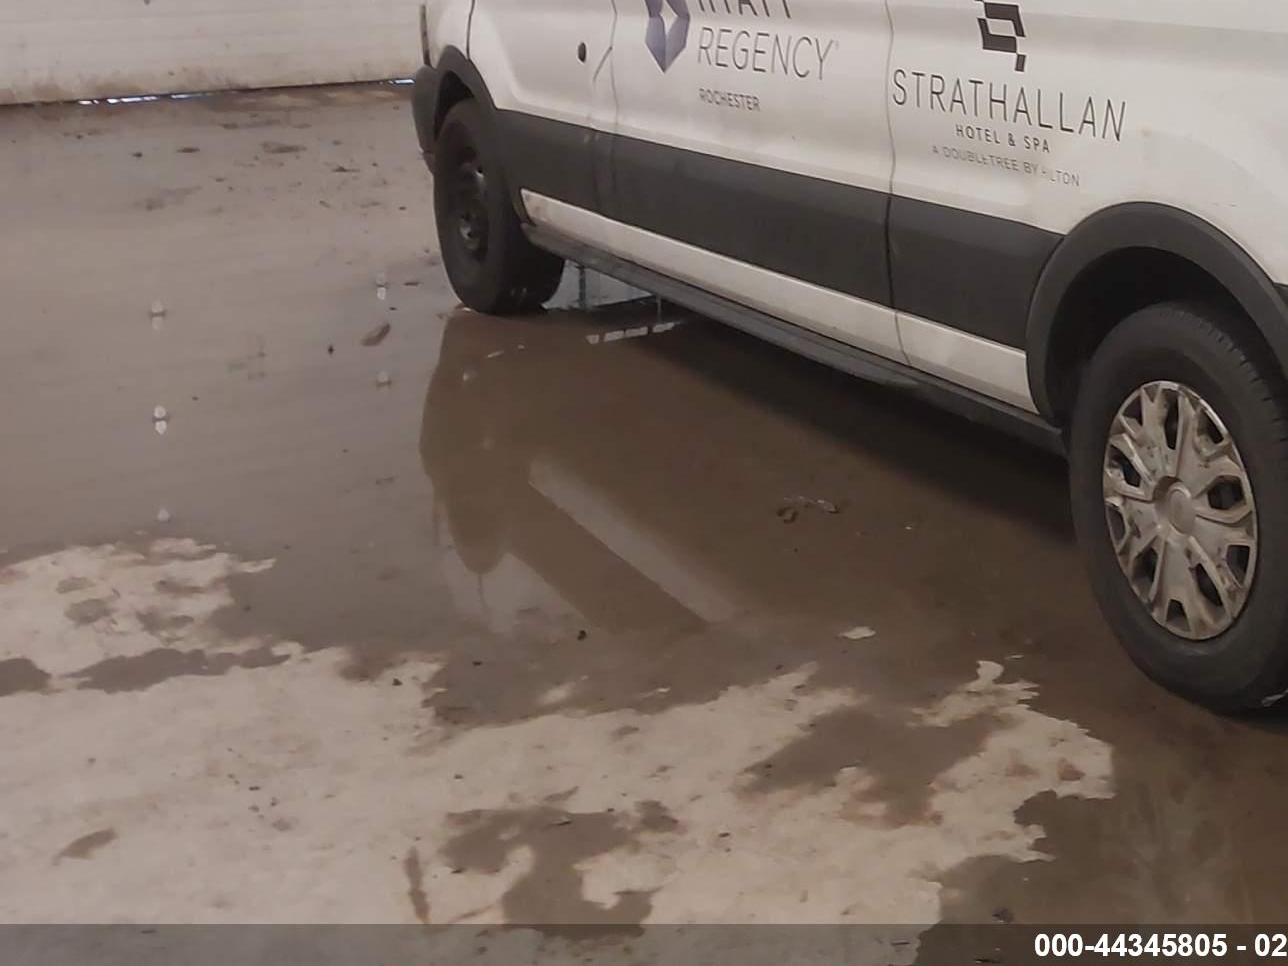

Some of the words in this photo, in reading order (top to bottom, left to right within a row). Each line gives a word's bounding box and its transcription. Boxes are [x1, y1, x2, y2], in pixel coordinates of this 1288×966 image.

[698, 27, 834, 81] REGENCY
[699, 88, 761, 112] ROCHESTER
[893, 69, 1128, 142] STRATHALLAN
[955, 124, 1001, 145] HOTEL
[1007, 132, 1017, 147] &
[1023, 135, 1051, 154] SPA
[932, 145, 940, 155] A
[1023, 161, 1039, 174] BY
